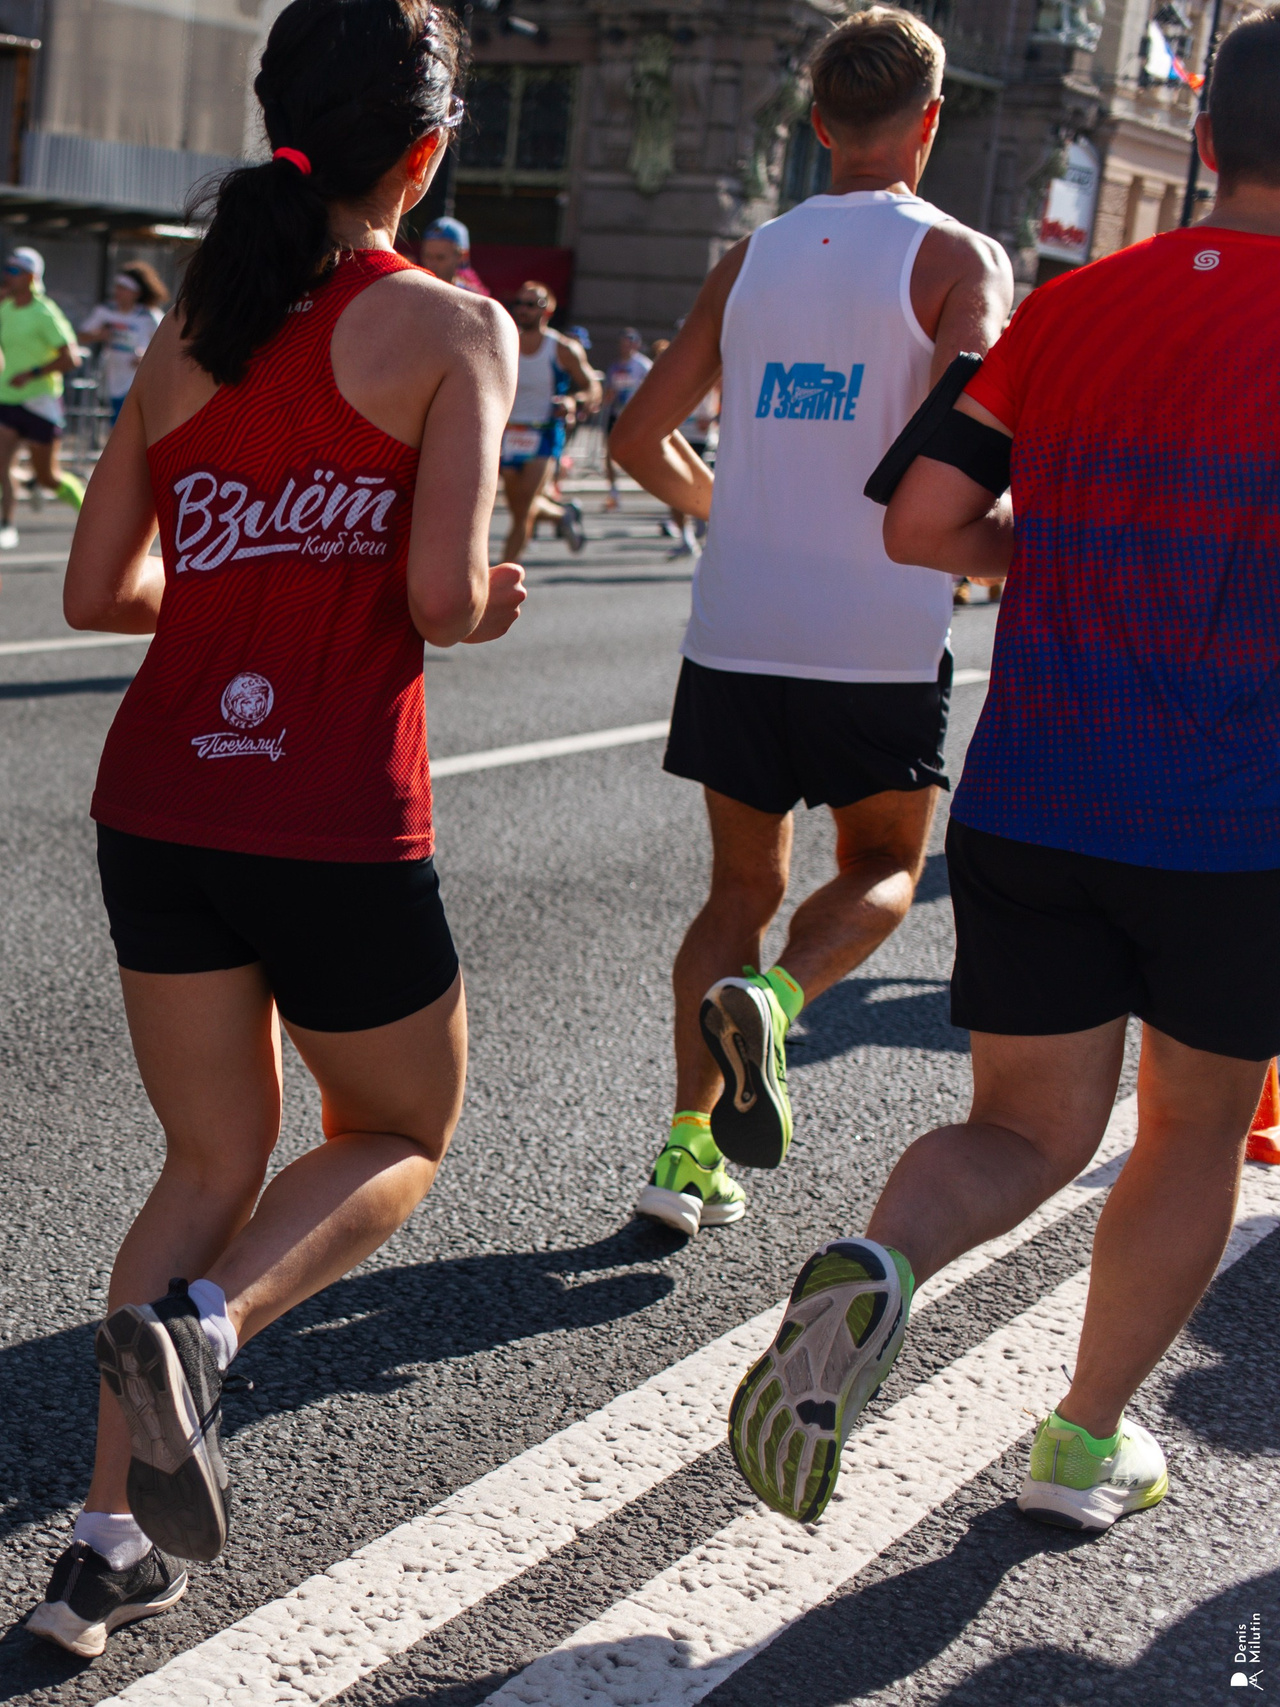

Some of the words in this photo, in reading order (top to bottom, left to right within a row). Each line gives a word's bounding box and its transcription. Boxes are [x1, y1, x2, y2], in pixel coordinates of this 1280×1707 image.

[173, 468, 397, 572] Взлёт
[301, 531, 348, 562] Клуб
[348, 531, 387, 556] бега
